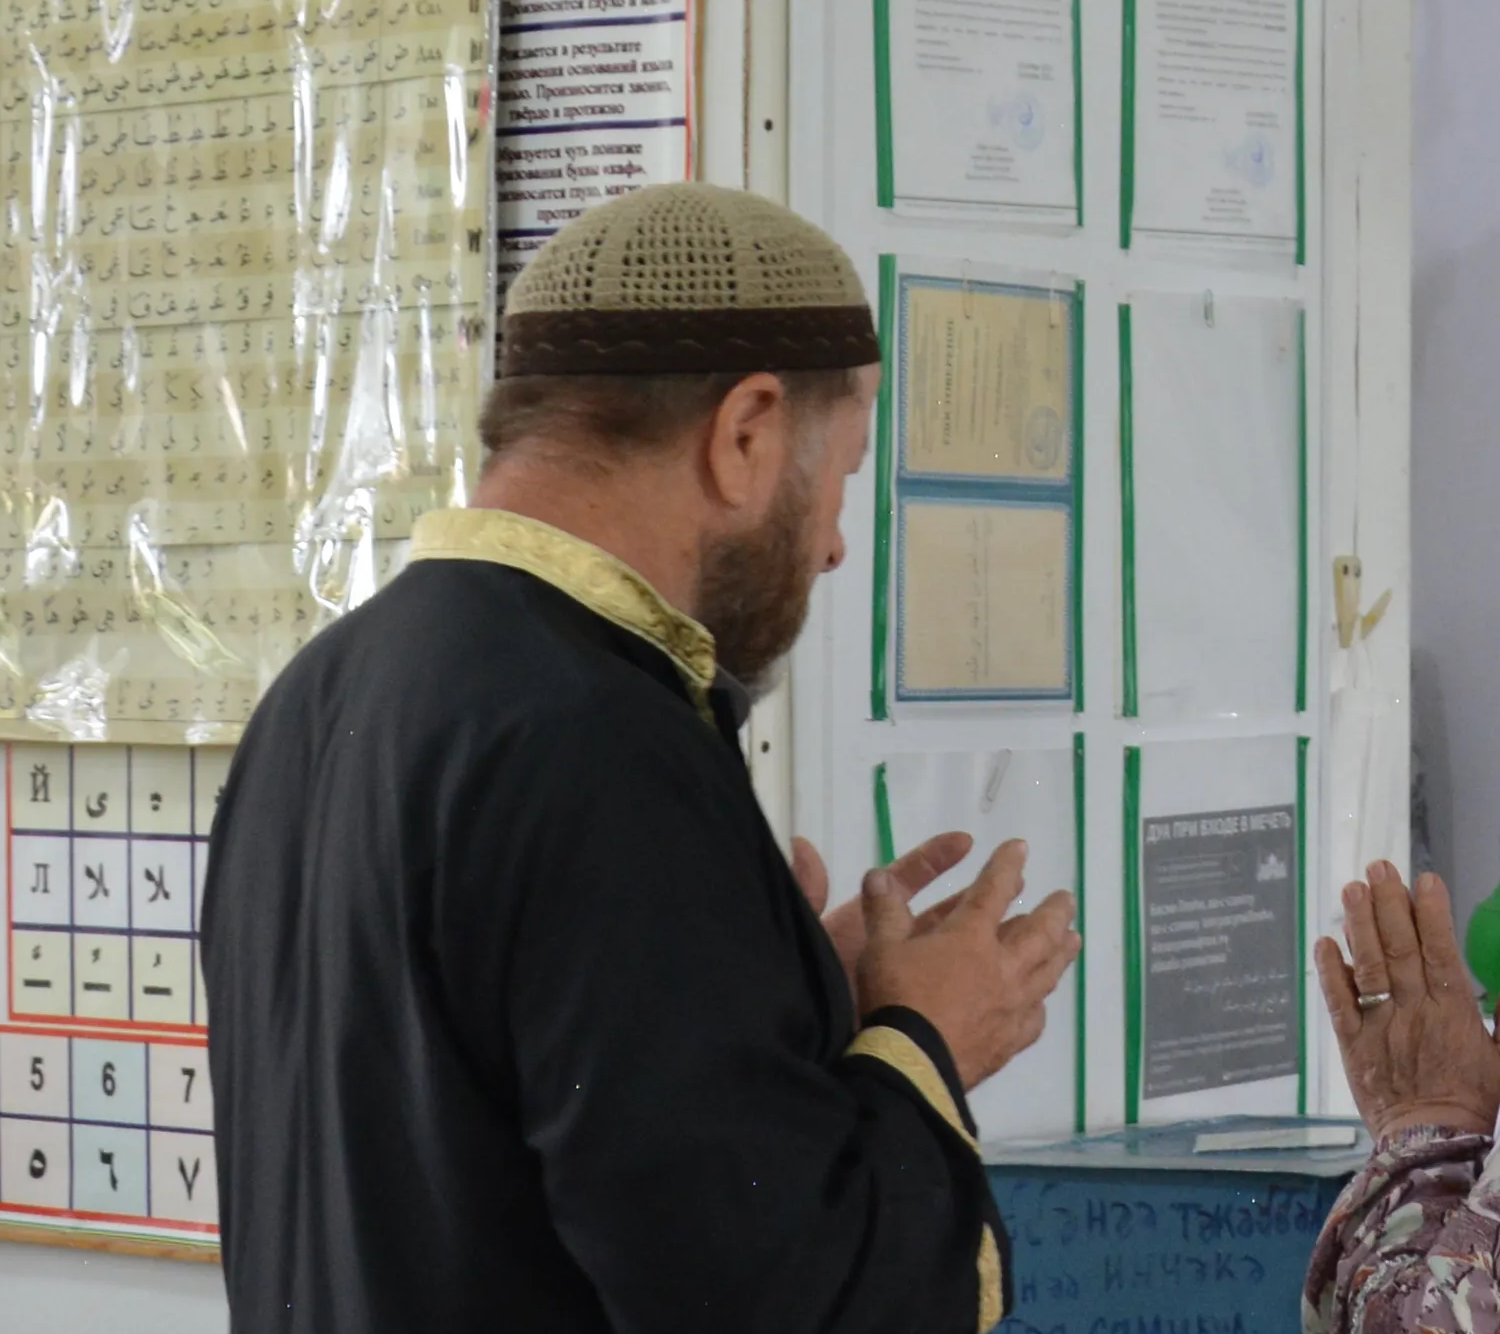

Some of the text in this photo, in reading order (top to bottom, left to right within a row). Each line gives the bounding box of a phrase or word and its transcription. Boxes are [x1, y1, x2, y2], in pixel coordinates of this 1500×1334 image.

[30, 764, 50, 802] Й
[31, 863, 50, 893] Л
[31, 1057, 44, 1091] 5
[102, 1062, 115, 1096] 6
[182, 1068, 195, 1102] 7
